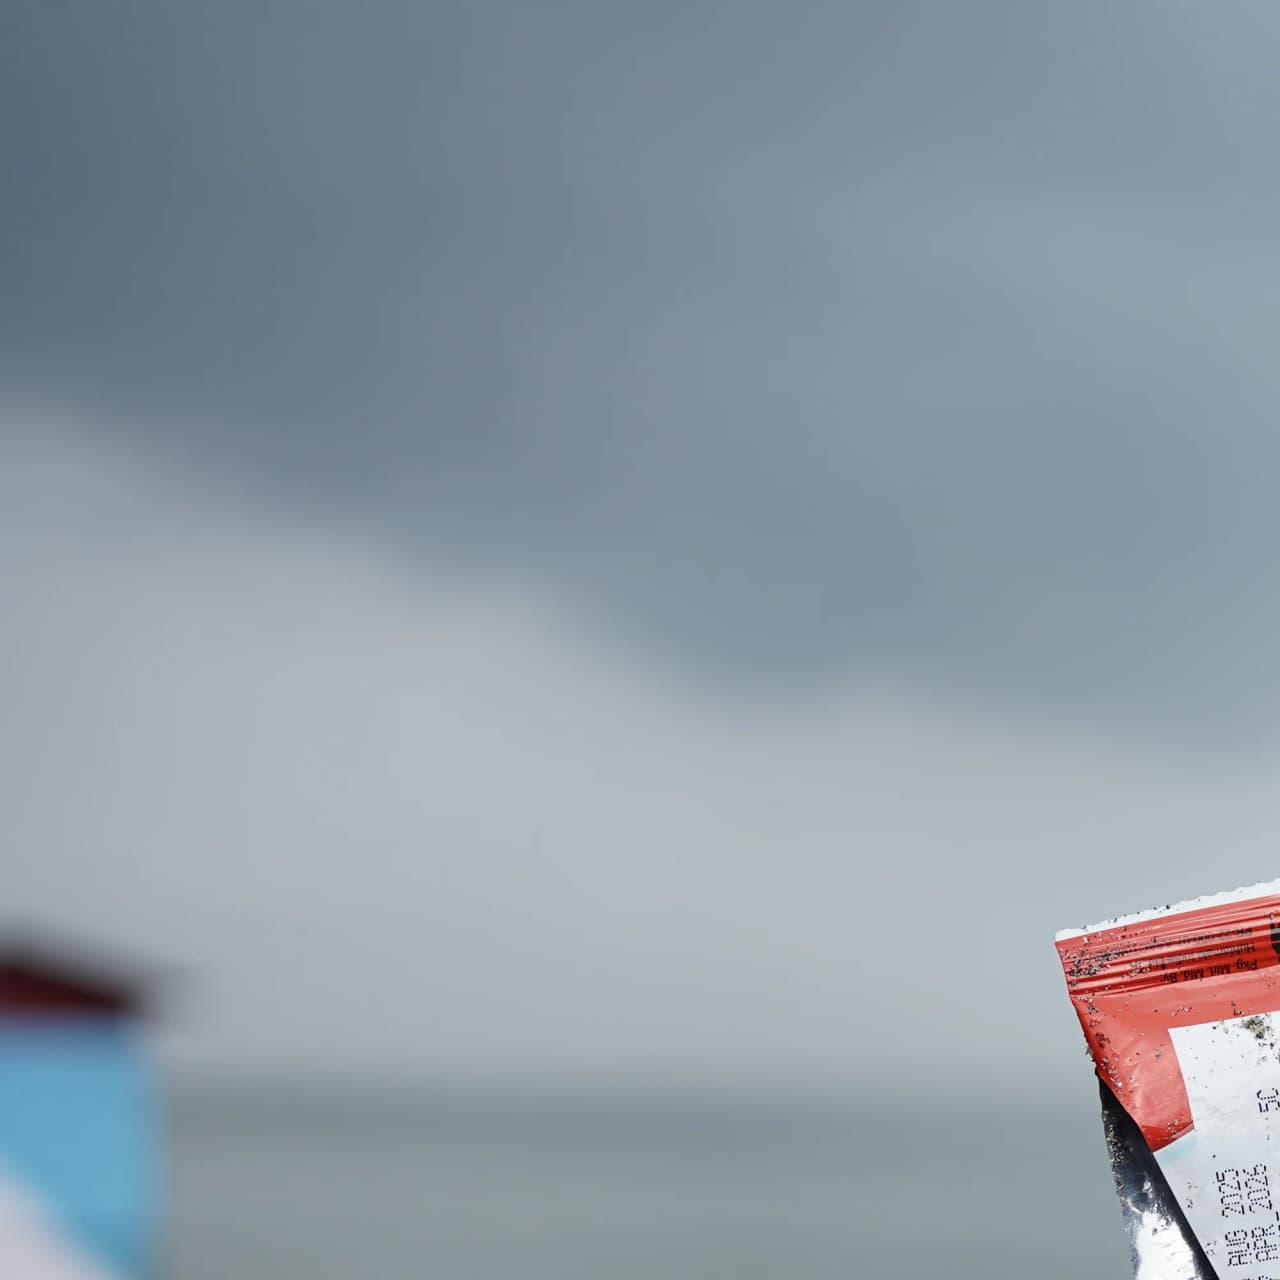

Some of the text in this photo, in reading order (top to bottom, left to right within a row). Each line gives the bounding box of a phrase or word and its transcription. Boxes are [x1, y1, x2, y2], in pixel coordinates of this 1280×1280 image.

[1216, 1169, 1244, 1217] 2025
[1243, 1164, 1278, 1261] APR 2026
[1225, 1230, 1252, 1266] AUG
